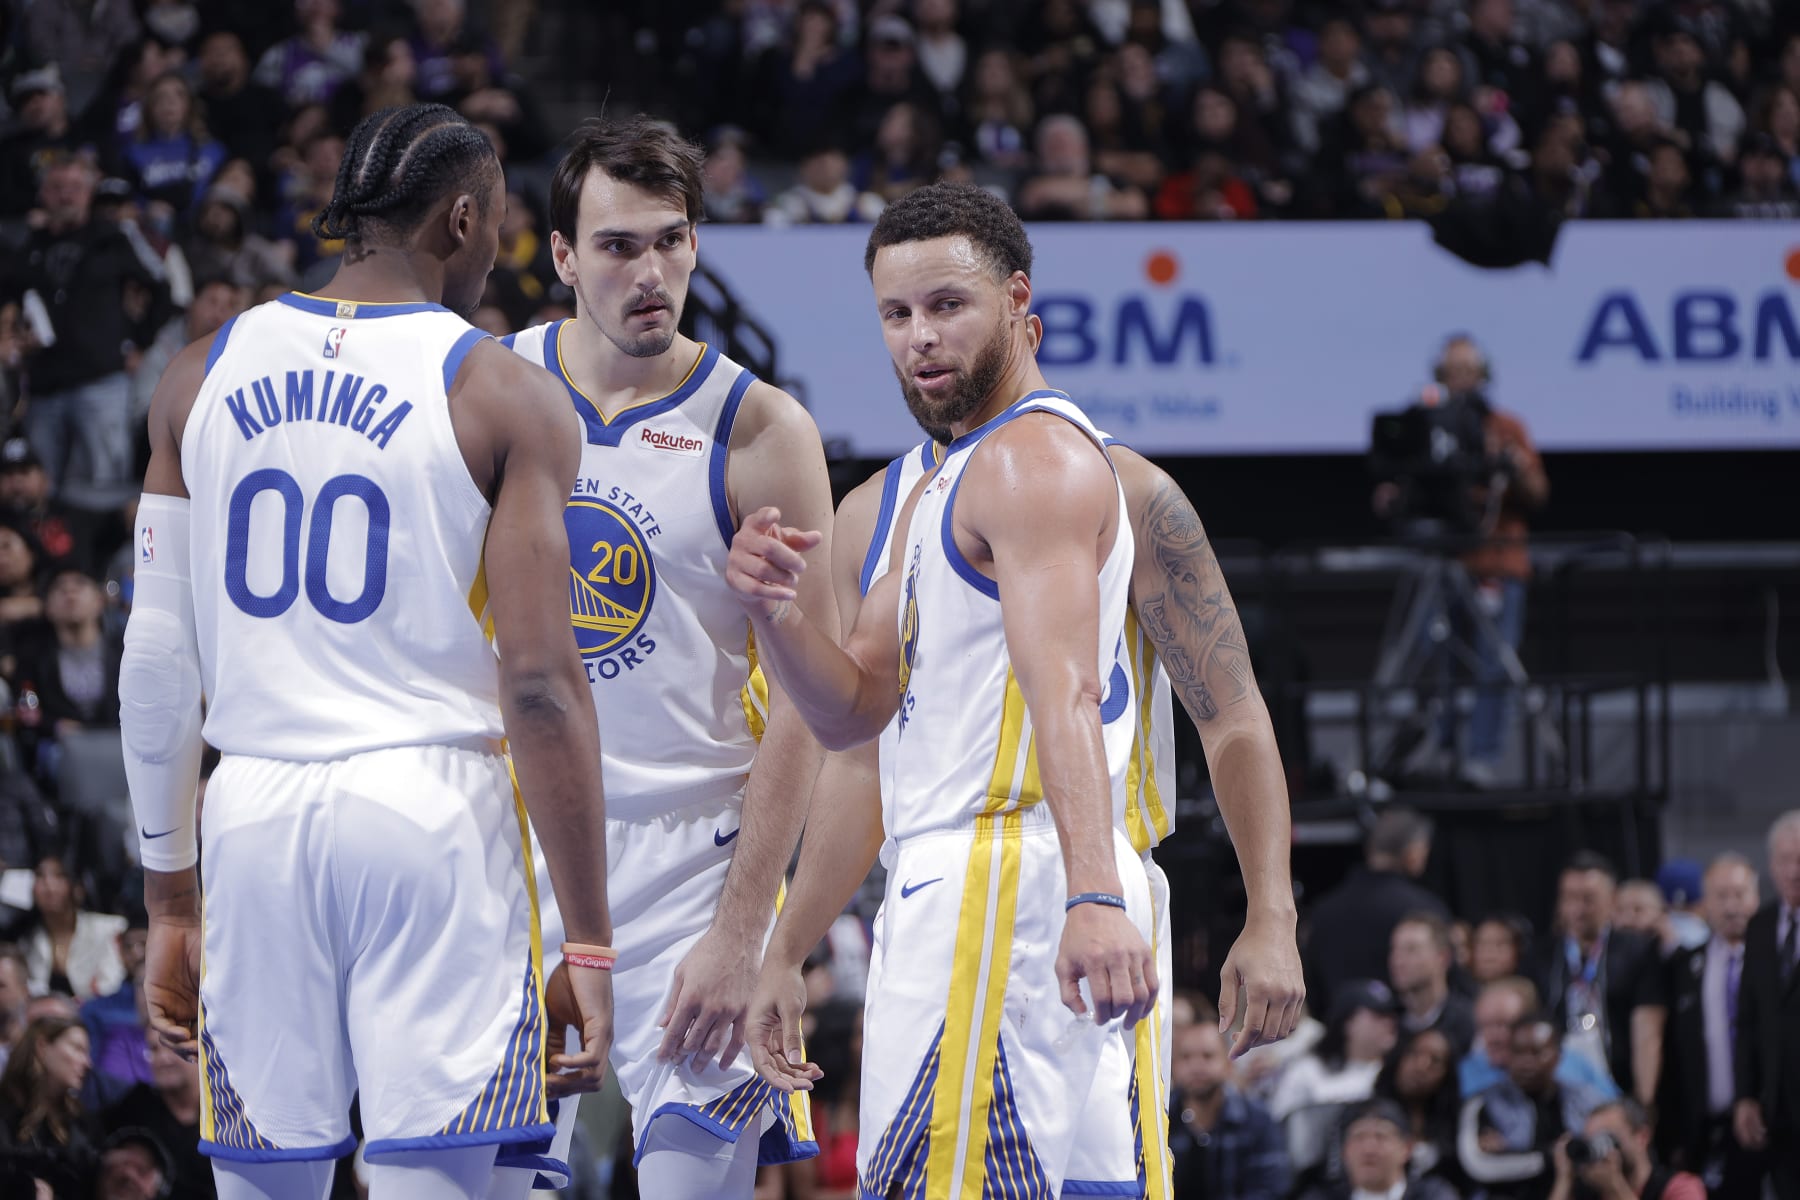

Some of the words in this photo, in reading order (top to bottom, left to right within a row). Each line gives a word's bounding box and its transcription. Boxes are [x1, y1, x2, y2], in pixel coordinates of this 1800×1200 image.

[1032, 294, 1214, 365] BM
[225, 369, 414, 450] KUMINGA
[640, 428, 703, 451] Rakuten
[573, 478, 600, 494] EN
[608, 486, 661, 539] STATE
[224, 468, 390, 624] 00
[588, 540, 638, 585] 20
